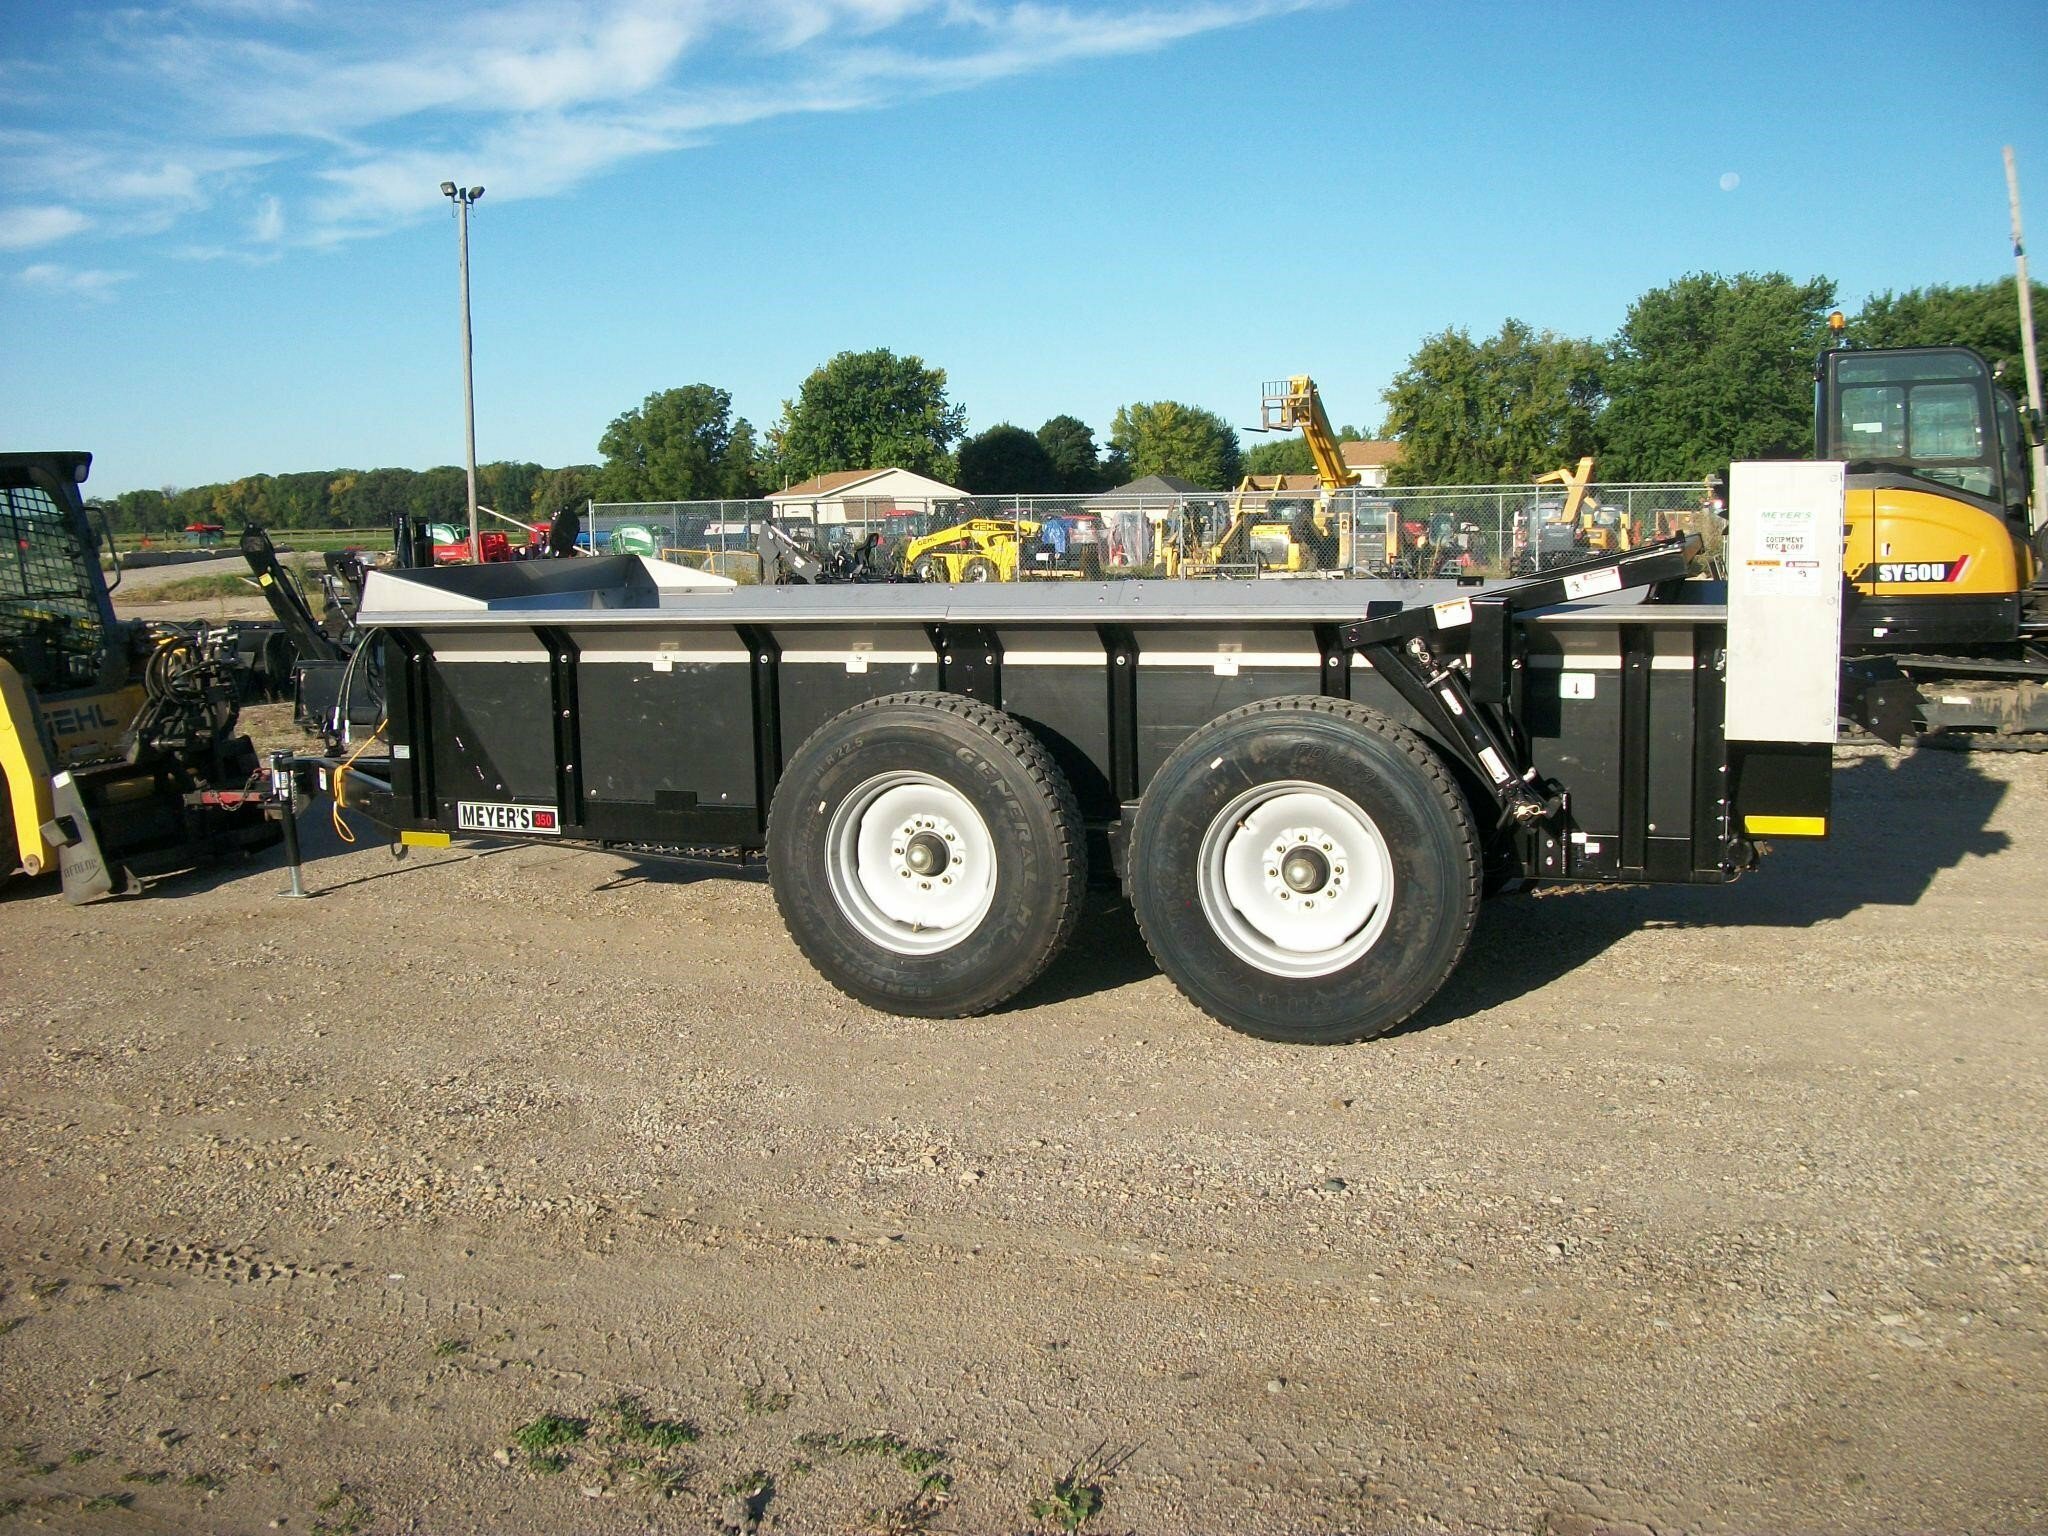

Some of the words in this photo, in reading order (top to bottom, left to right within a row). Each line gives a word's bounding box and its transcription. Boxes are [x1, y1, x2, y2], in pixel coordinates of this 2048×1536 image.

[1761, 511, 1813, 520] MEYER'S
[972, 522, 1001, 531] GEHL
[917, 536, 937, 547] GEHL
[1879, 563, 1945, 582] SY50U
[44, 704, 119, 736] EHL
[462, 805, 531, 829] MEYER'S
[535, 813, 553, 826] 350
[955, 747, 1038, 888] GENERAL
